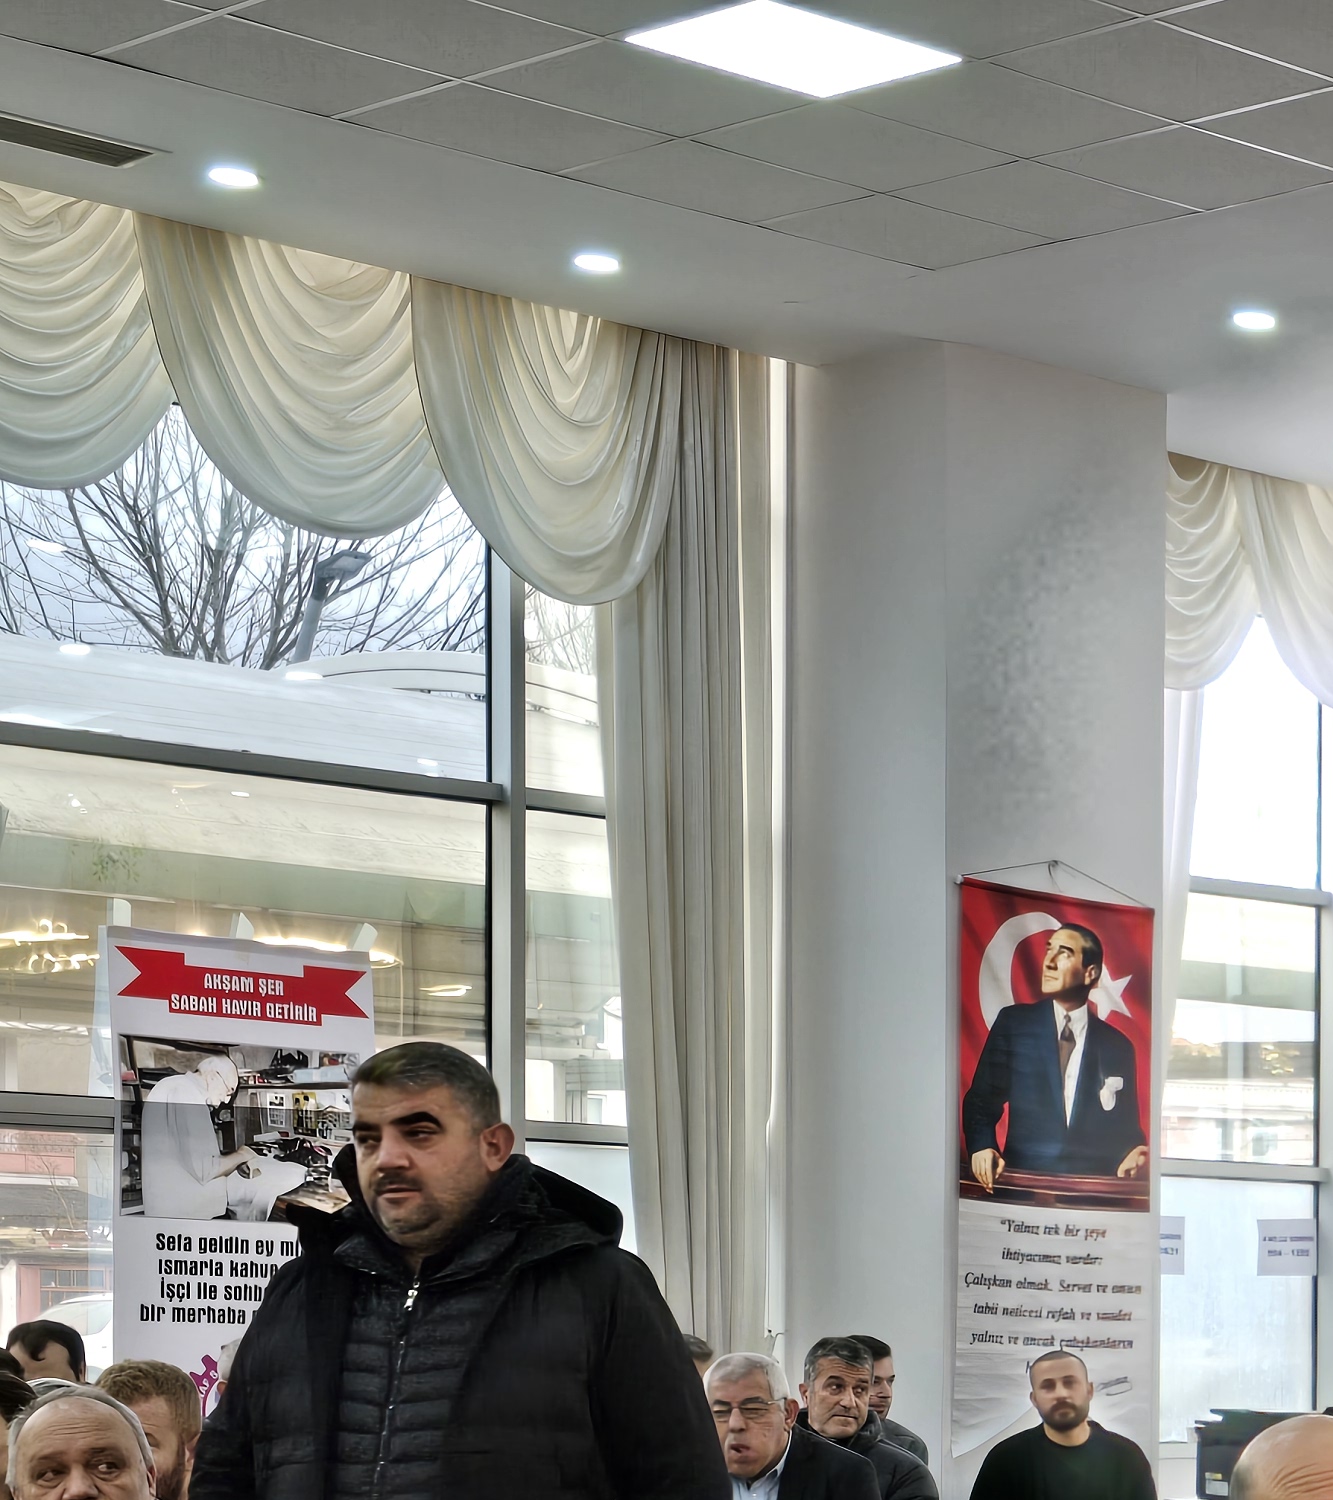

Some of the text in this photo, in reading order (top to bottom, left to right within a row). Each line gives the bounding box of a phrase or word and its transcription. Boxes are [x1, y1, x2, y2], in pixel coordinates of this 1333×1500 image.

[204, 973, 284, 997] AKŞAM ŞER
[171, 993, 217, 1013] SABAH
[198, 1236, 250, 1255] geldin
[255, 1239, 274, 1257] ey
[139, 1303, 166, 1322] bir
[171, 1305, 246, 1325] merhaba
